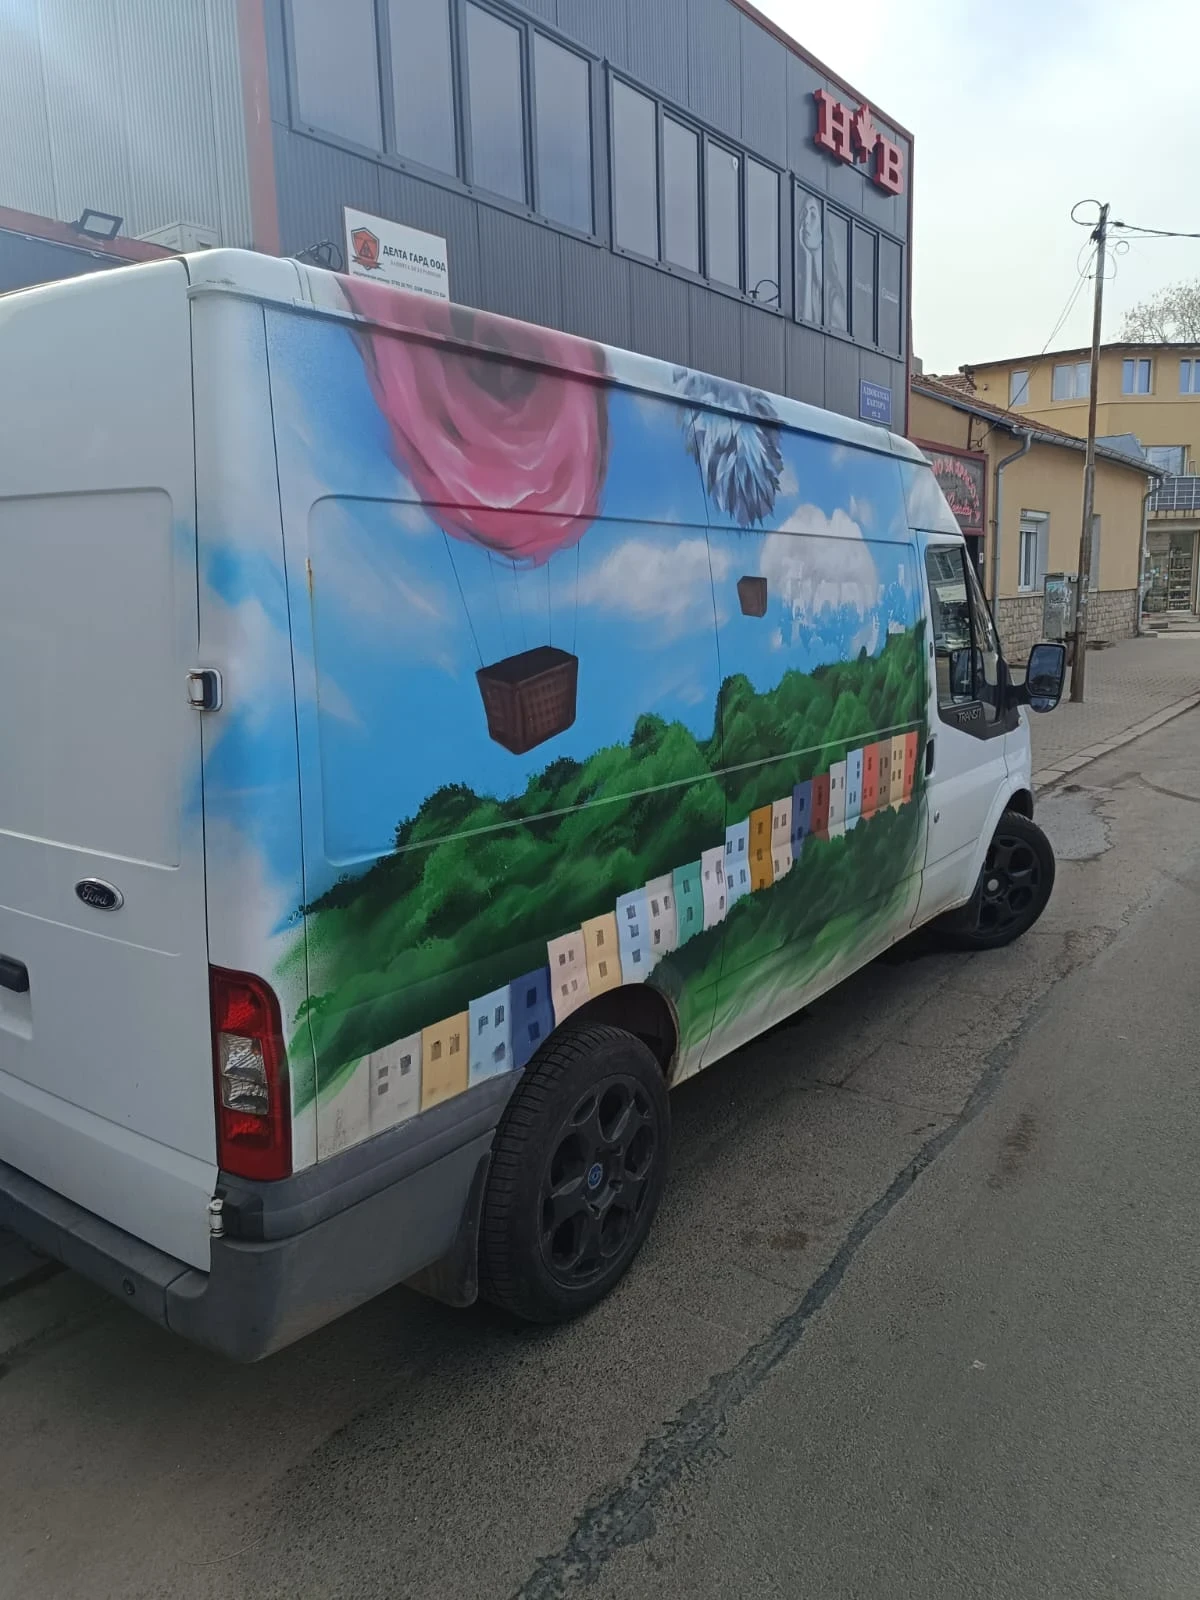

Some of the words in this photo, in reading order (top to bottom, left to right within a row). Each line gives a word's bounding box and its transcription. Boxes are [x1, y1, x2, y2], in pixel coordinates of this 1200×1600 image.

[383, 245, 408, 261] ДЕЛТА
[409, 252, 429, 268] ГАРД
[430, 259, 446, 273] ООД
[81, 884, 109, 905] Ford
